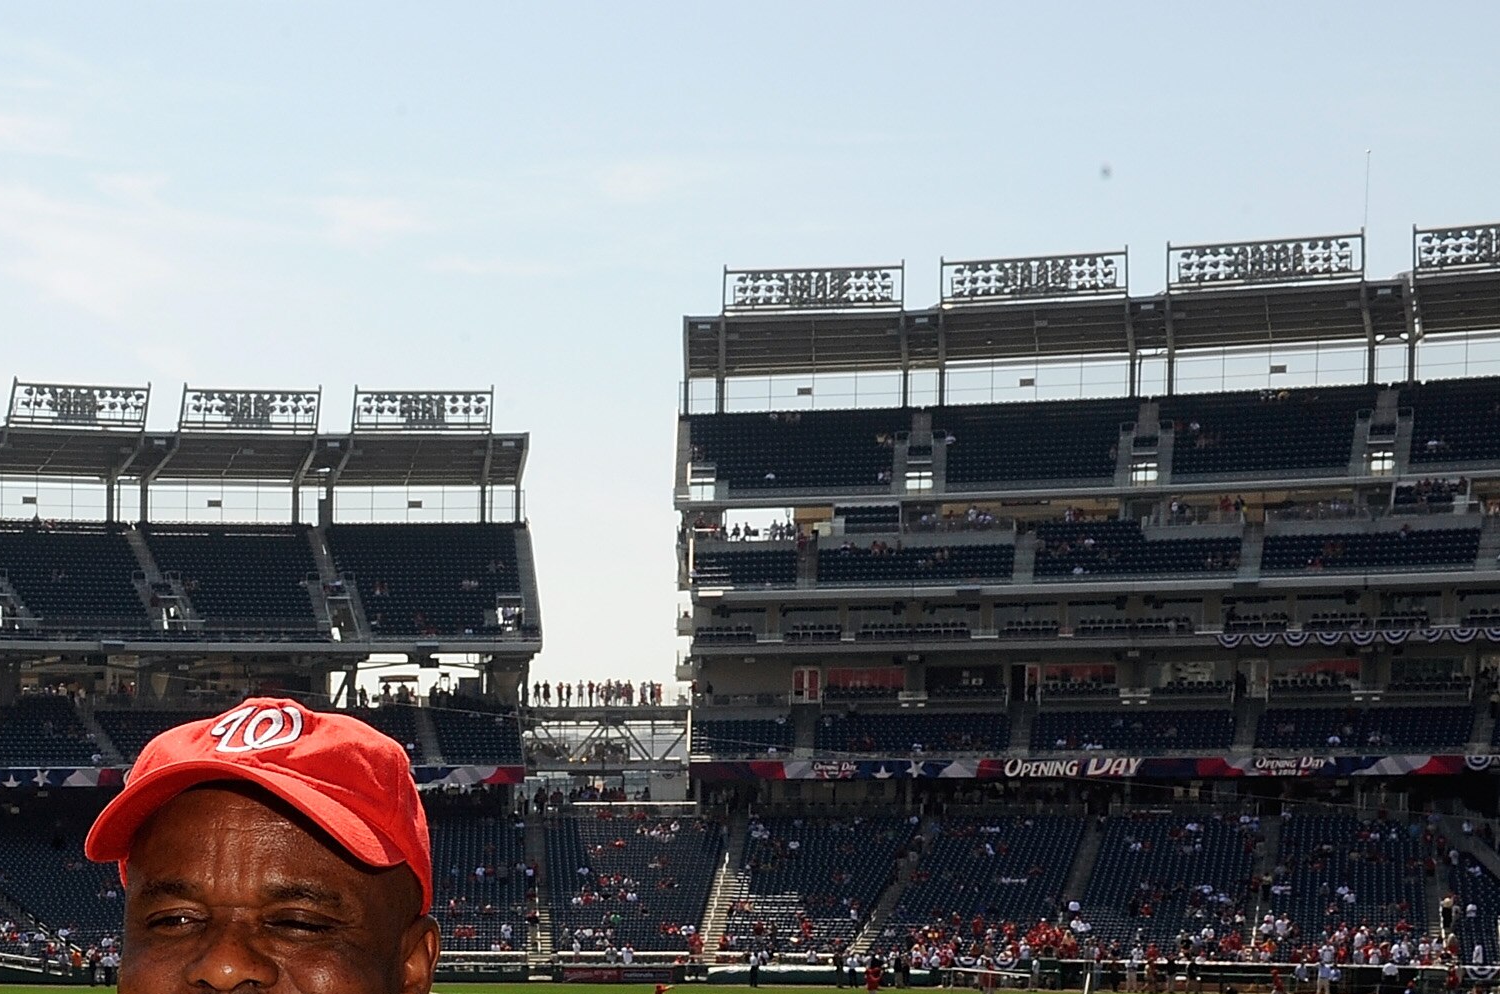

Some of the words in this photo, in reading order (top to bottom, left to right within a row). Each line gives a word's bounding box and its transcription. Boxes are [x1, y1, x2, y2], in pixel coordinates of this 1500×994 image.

[212, 706, 302, 752] W
[1004, 758, 1079, 777] OPENING
[1087, 757, 1142, 775] DAY
[1255, 757, 1297, 768] OPENING
[1300, 756, 1327, 768] DAY
